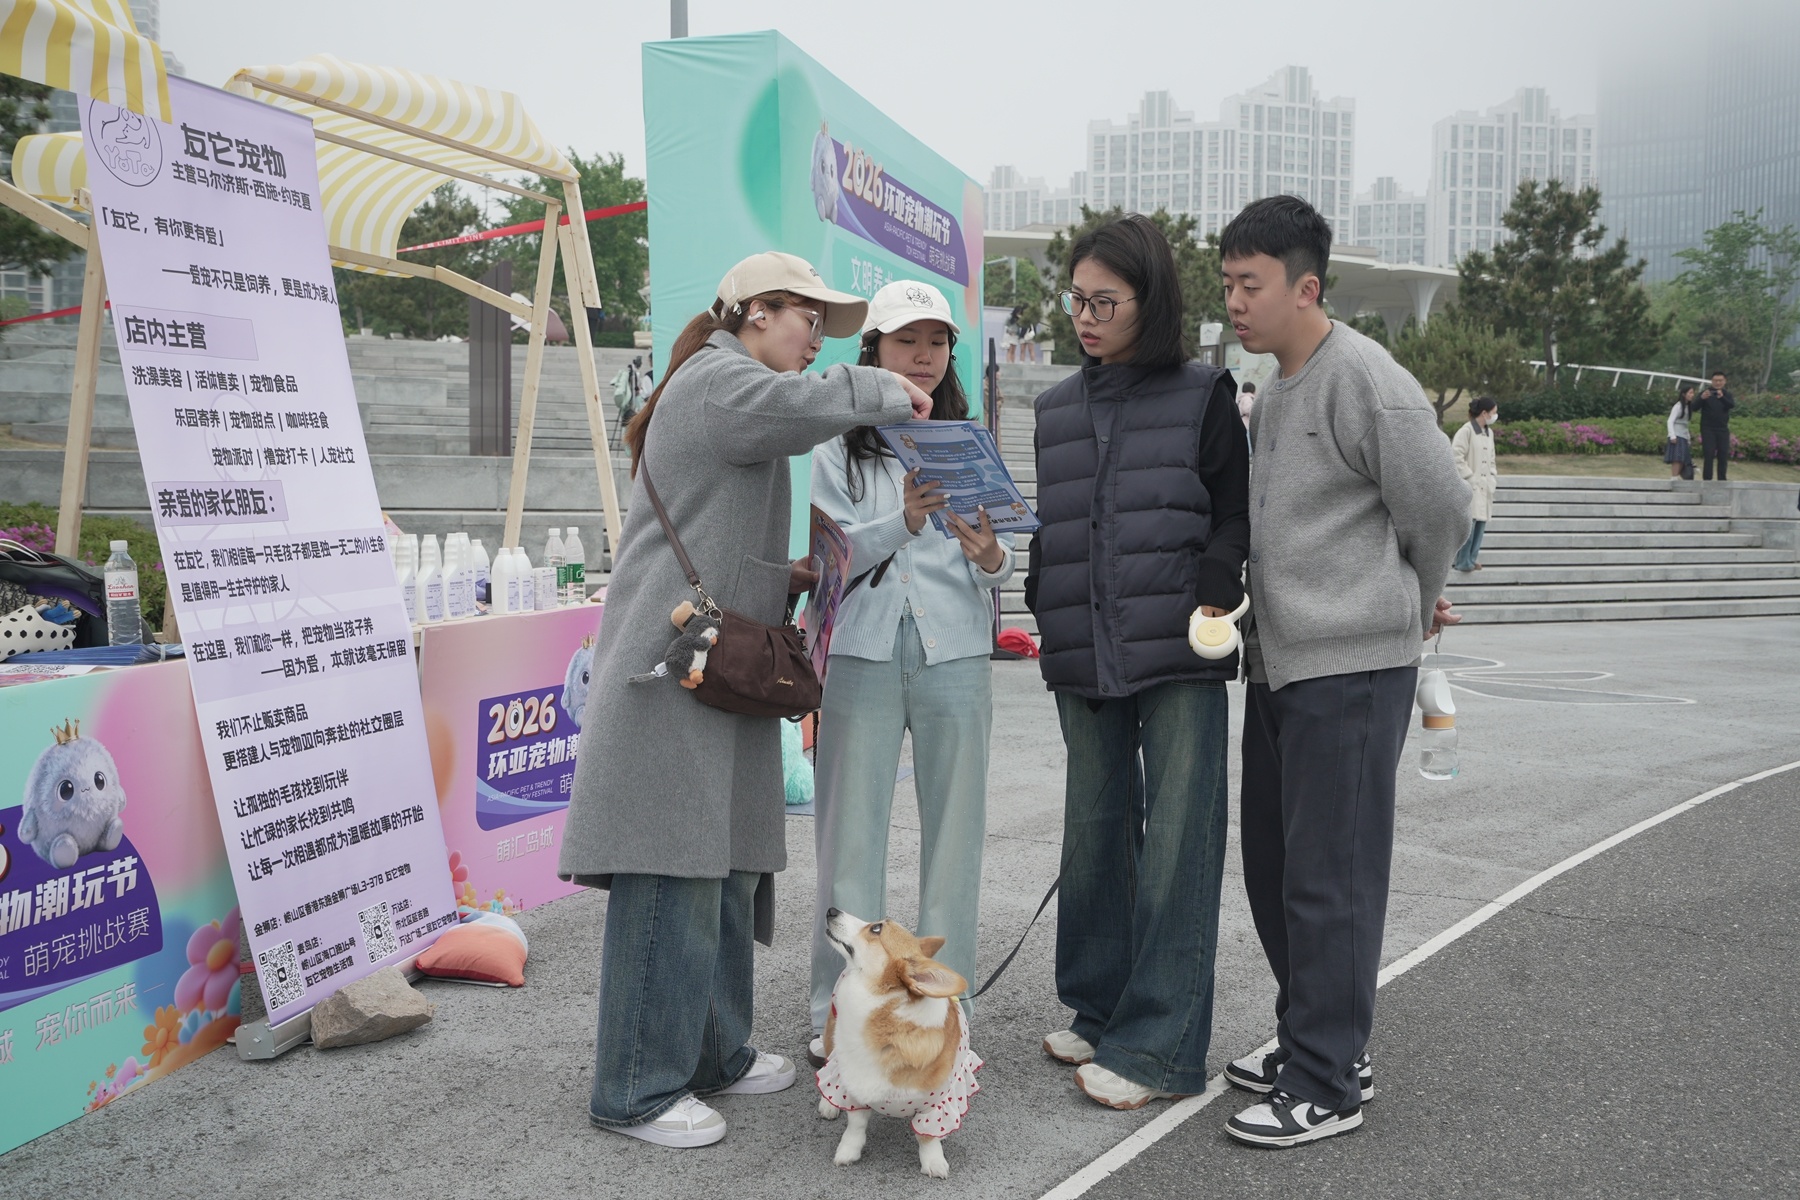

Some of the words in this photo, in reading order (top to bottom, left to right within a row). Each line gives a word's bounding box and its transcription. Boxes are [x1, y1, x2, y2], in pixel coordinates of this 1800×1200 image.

[181, 122, 287, 179] 友它宠物
[842, 141, 884, 209] 2026
[883, 181, 951, 246] 环亚宠物潮玩节
[437, 238, 460, 246] LIMIT
[464, 232, 484, 242] LINE
[125, 315, 207, 350] 店内主营
[132, 365, 183, 387] 洗澡美容
[195, 370, 240, 391] 活体售卖
[250, 374, 298, 393] 宠物食品
[174, 408, 221, 428] 乐园寄养
[229, 410, 276, 429] 宠物甜点
[285, 412, 329, 429] 咖啡轻食
[212, 447, 254, 466] 宠物派对
[264, 446, 308, 465] 撸宠打卡
[320, 446, 355, 464] 人宠社交
[158, 488, 276, 519] 亲爱的家长朋友：
[180, 574, 290, 603] 是值得用一生去守护的家人
[216, 703, 309, 740] 我们不止贩卖商品
[487, 693, 556, 745] 2026
[222, 710, 405, 771] 更搭建人与宠物双向奔赴的社交圈层
[233, 768, 350, 818] 让孤独的毛孩找到玩伴
[520, 785, 530, 793] PET
[534, 779, 555, 790] TRENDY
[531, 788, 554, 798] FESTIVAL
[240, 797, 356, 850] 让忙碌的家长找到共鸣
[248, 805, 425, 881] 让每一次相遇都成为温暖故事的开始
[496, 825, 555, 863] 萌汇岛城
[24, 907, 151, 977] 萌宠挑战赛
[305, 956, 355, 988] 友它宠物生活馆
[35, 981, 138, 1052] 宠你而来
